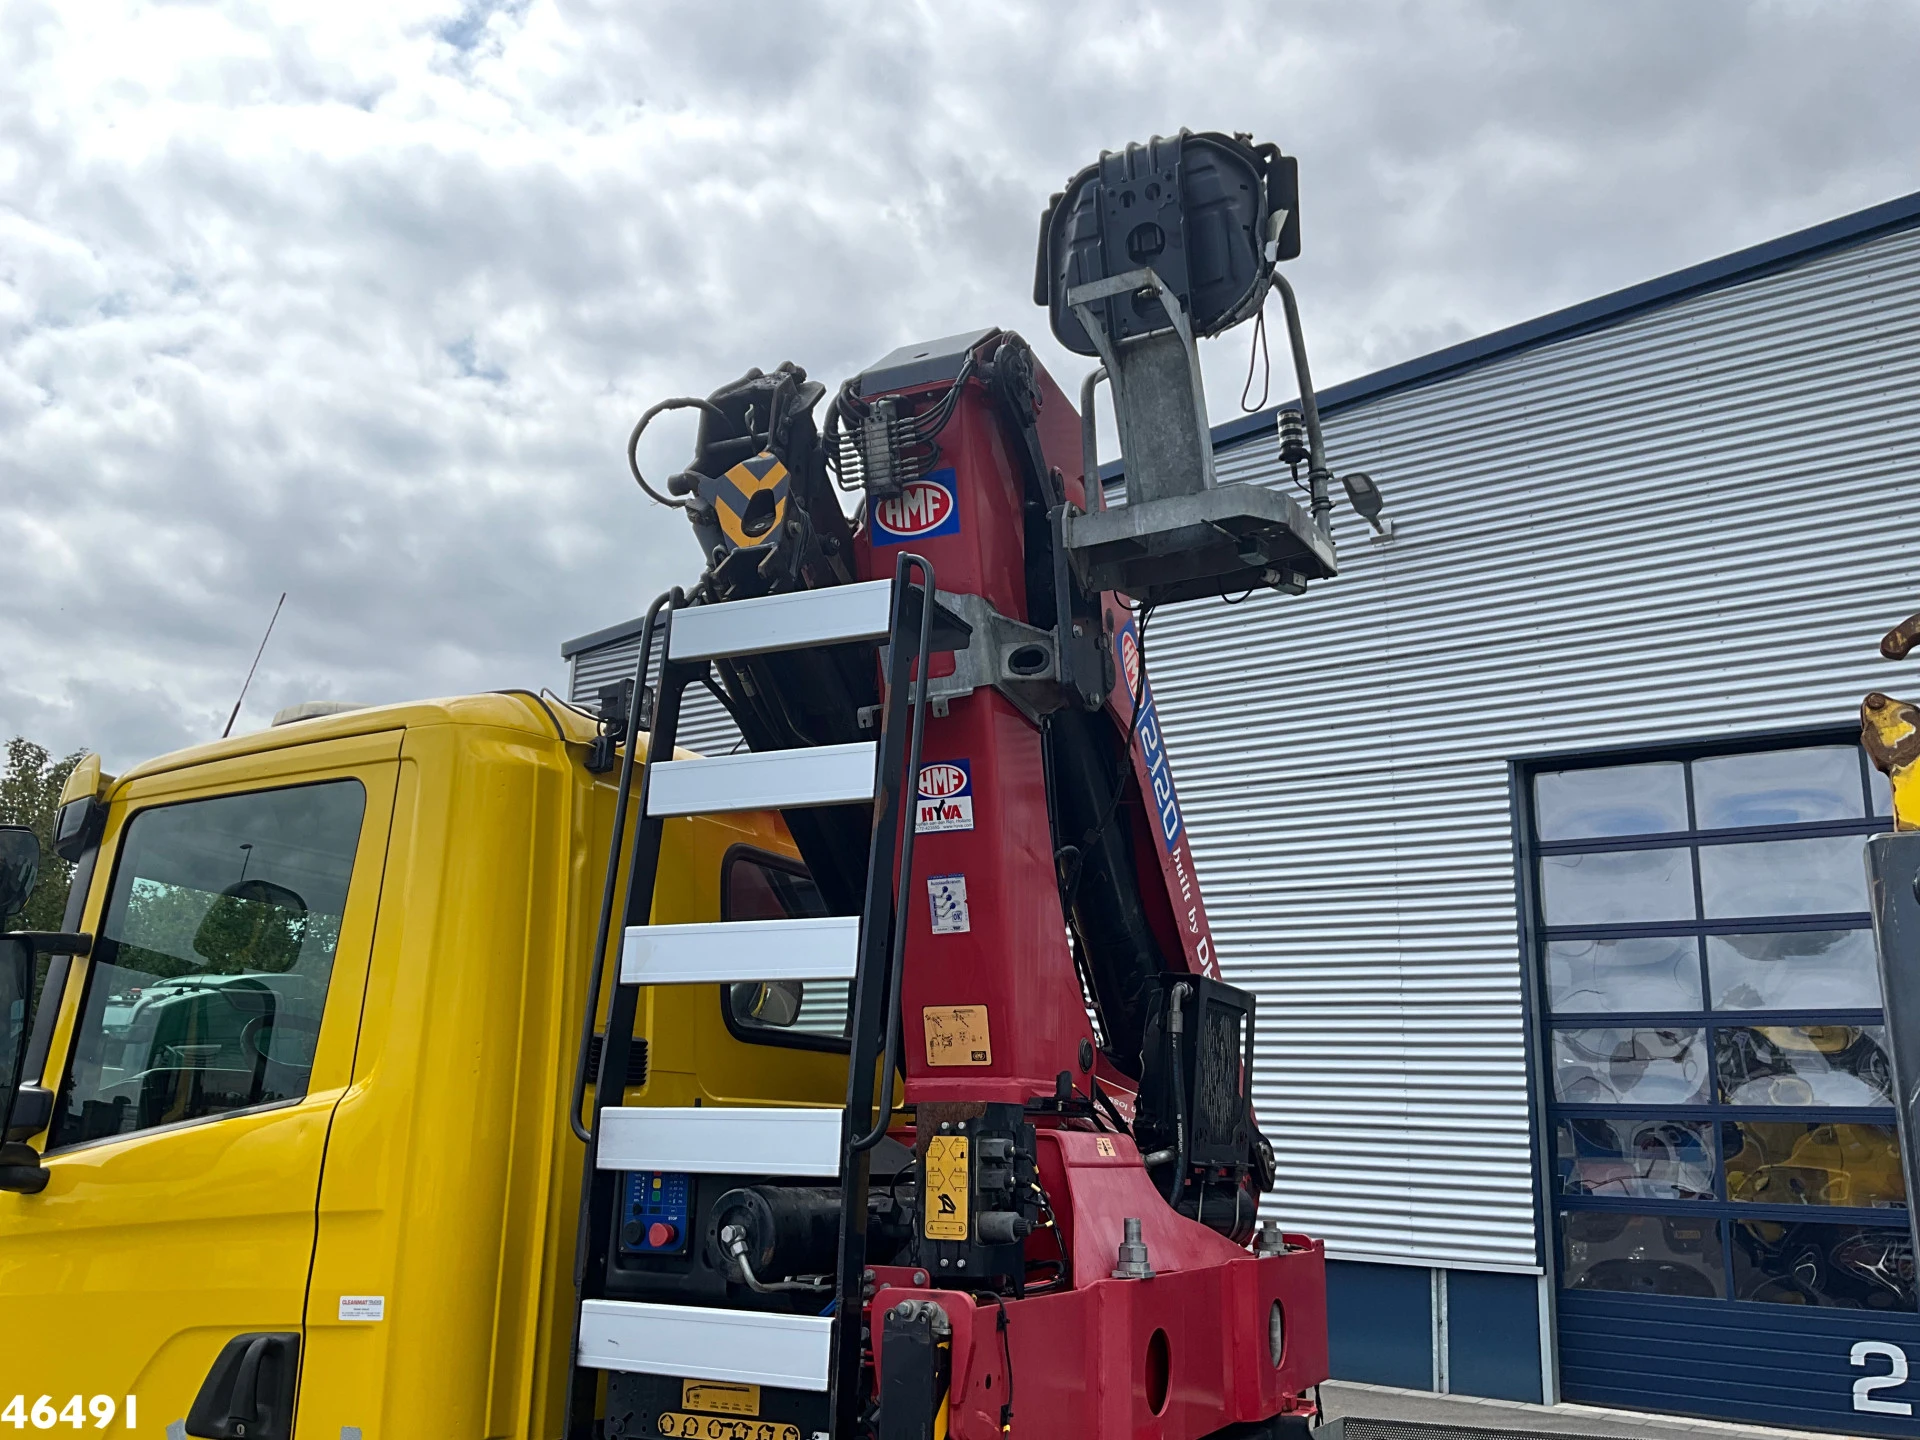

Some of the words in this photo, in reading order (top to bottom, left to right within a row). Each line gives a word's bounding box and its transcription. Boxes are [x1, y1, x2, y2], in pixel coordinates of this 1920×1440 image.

[885, 487, 942, 529] HMF
[919, 767, 959, 795] HMF
[1141, 715, 1178, 841] 2120
[921, 799, 963, 822] HYVA
[1173, 846, 1192, 903] built
[1188, 906, 1199, 934] by
[1850, 1341, 1912, 1415] 2
